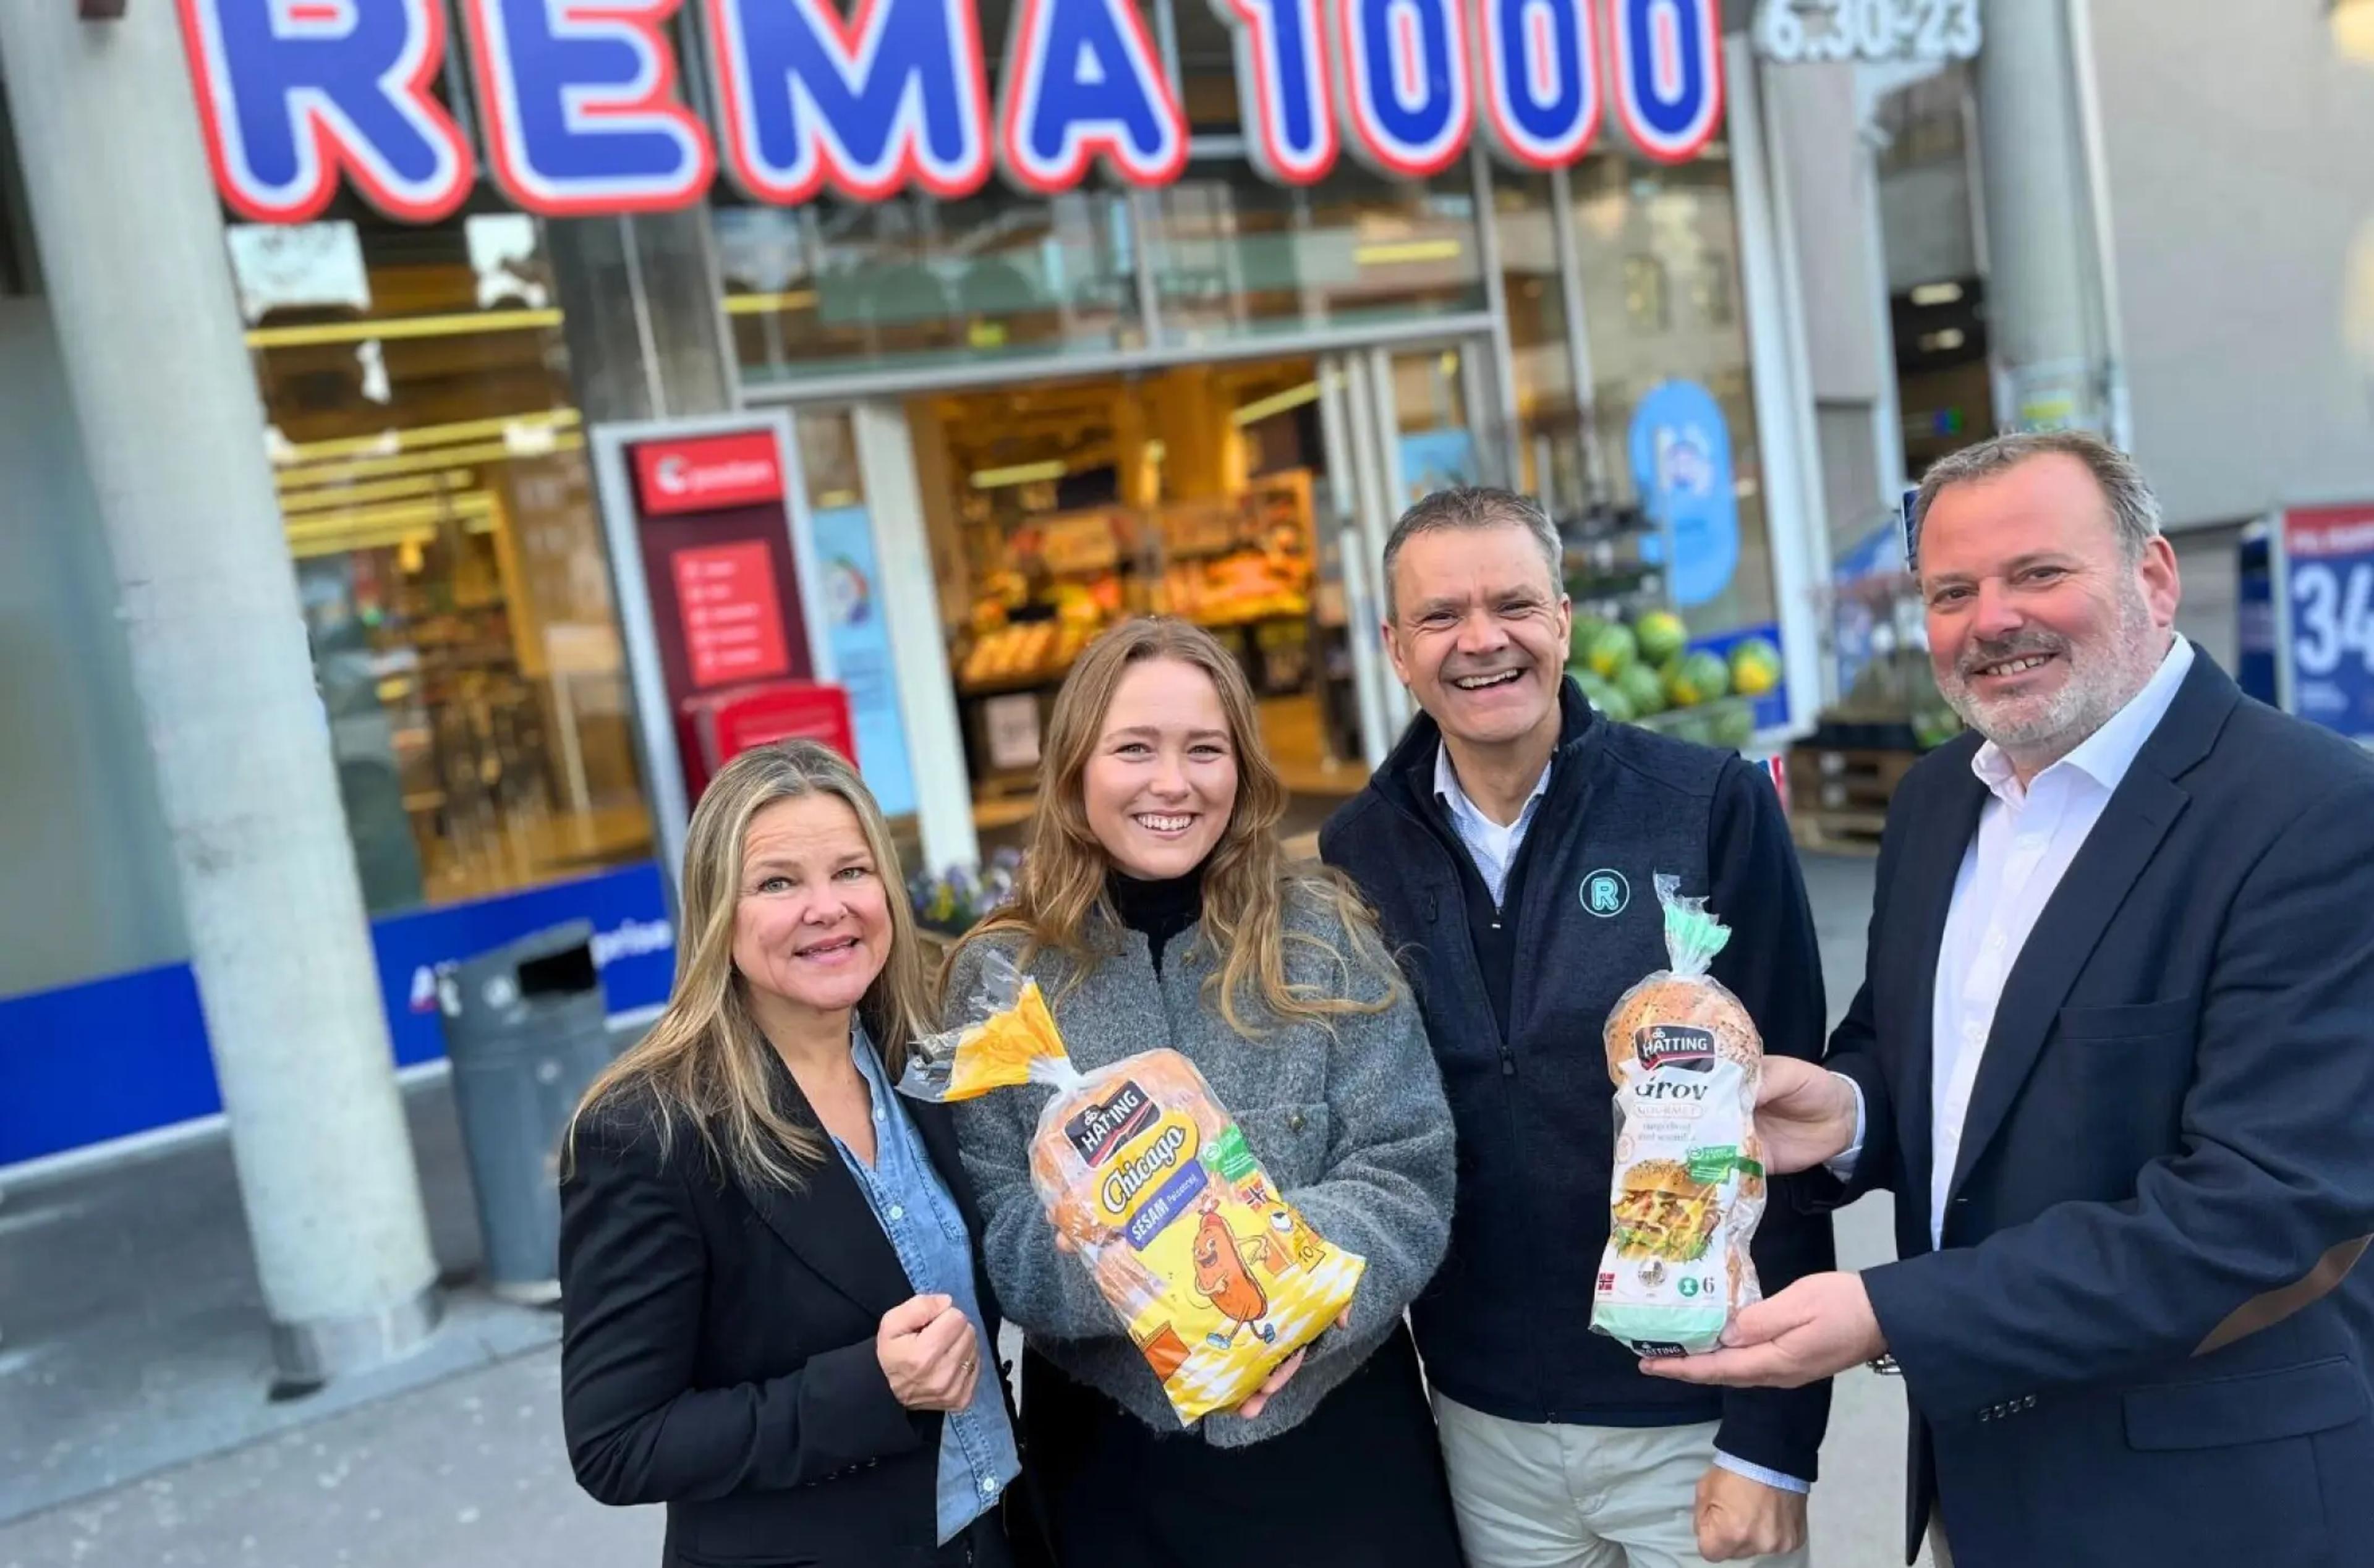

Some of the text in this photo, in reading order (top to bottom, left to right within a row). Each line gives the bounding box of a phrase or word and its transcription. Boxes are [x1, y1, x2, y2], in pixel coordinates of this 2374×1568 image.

[178, 0, 1725, 222] REMA 1000
[1591, 877, 1619, 910] R
[1642, 1036, 1708, 1058] HATTING
[1081, 1090, 1139, 1152] HATING
[1102, 1125, 1186, 1213] Chicago
[1131, 1197, 1169, 1241] SESAM
[1299, 1245, 1314, 1263] 10
[1703, 1276, 1715, 1294] 6
